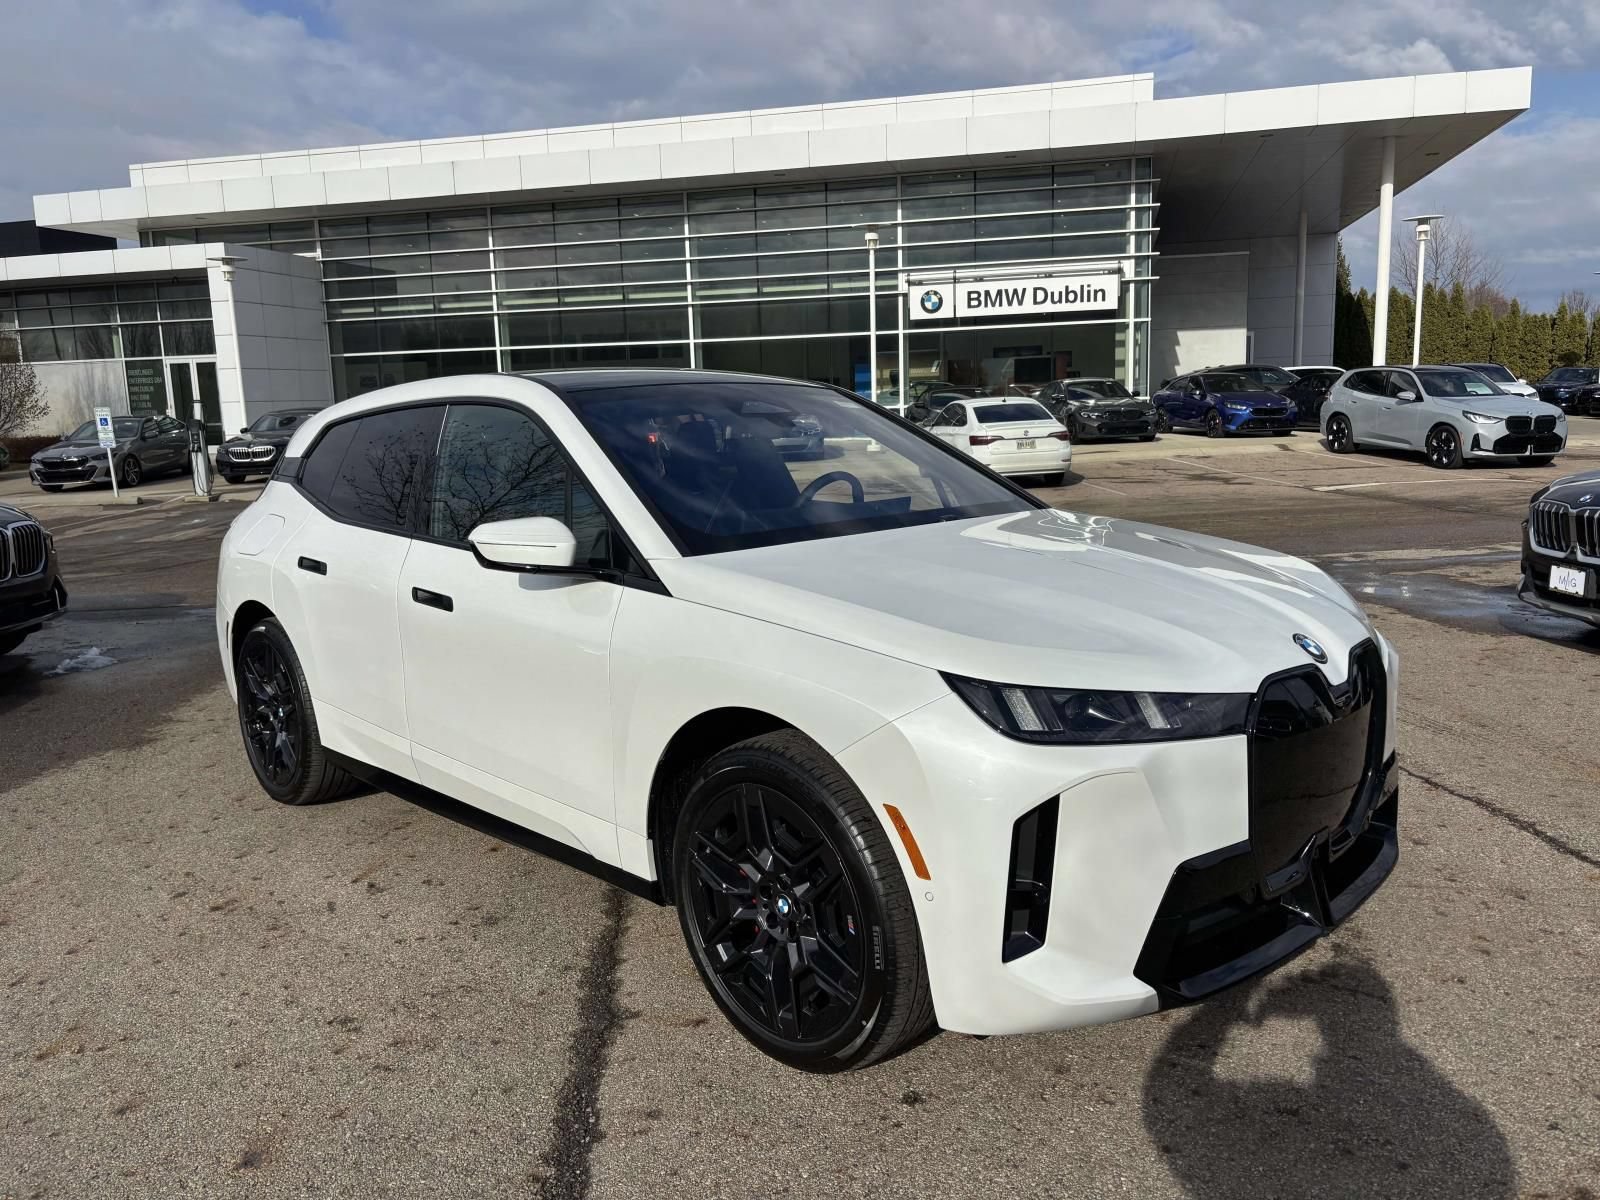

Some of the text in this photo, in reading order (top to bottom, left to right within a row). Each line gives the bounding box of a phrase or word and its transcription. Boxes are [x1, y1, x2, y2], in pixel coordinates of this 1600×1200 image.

[967, 284, 1106, 309] BMW Dublin
[872, 925, 884, 970] PIRELLI
